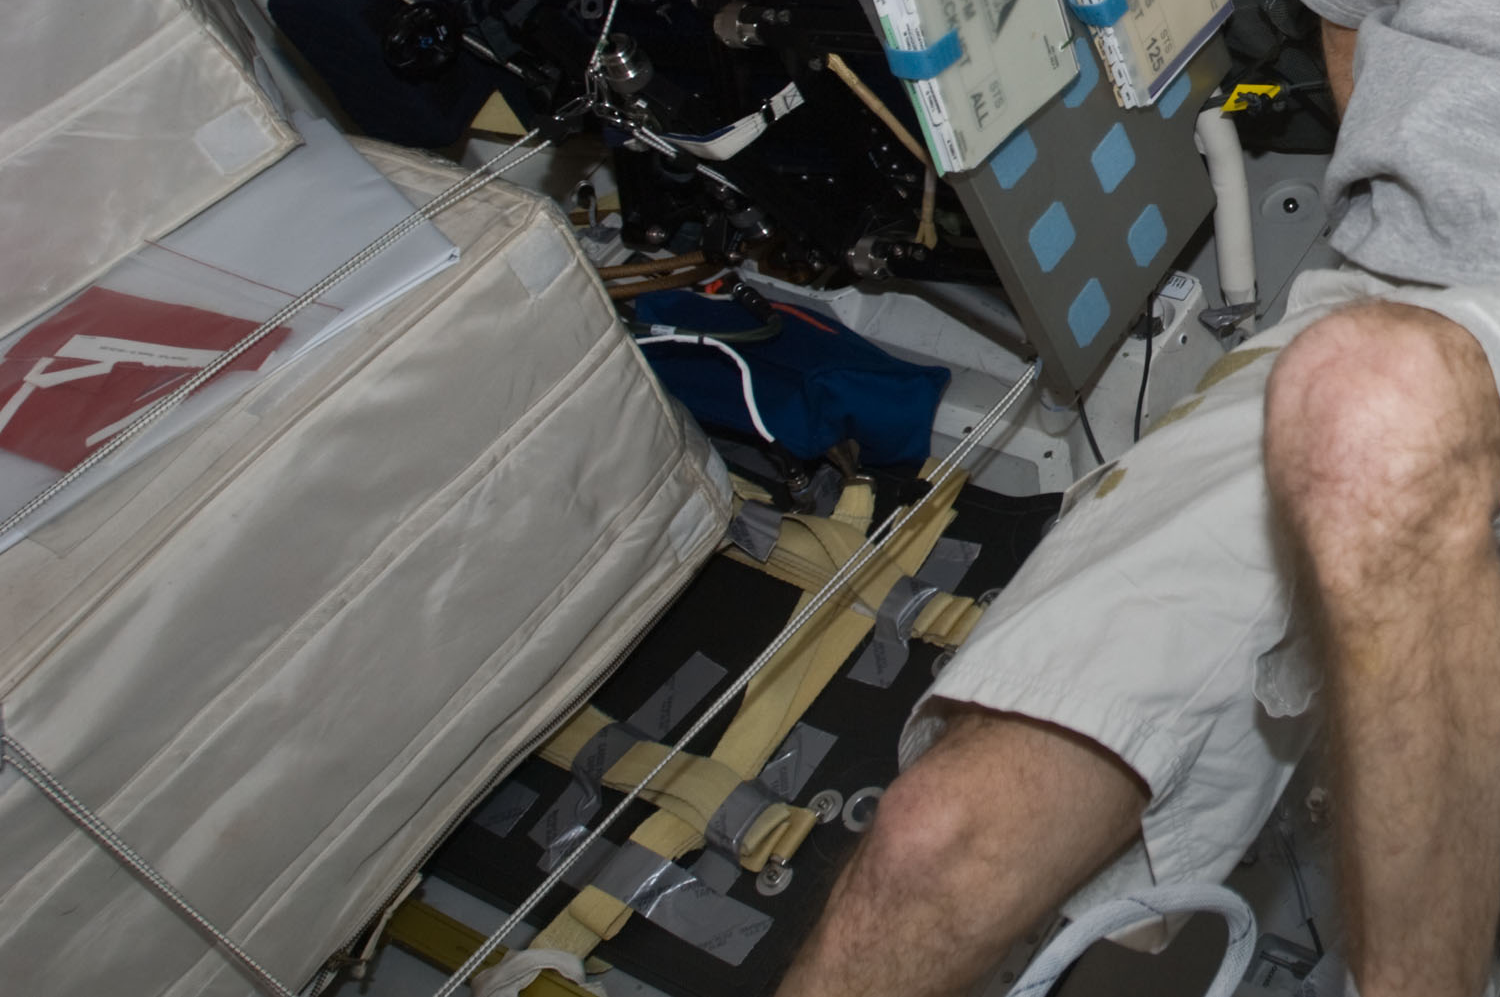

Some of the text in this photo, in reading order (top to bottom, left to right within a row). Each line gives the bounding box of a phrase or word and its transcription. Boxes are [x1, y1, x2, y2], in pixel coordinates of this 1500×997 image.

[1146, 37, 1165, 73] 125
[1158, 29, 1173, 54] STS
[970, 91, 990, 130] ALL
